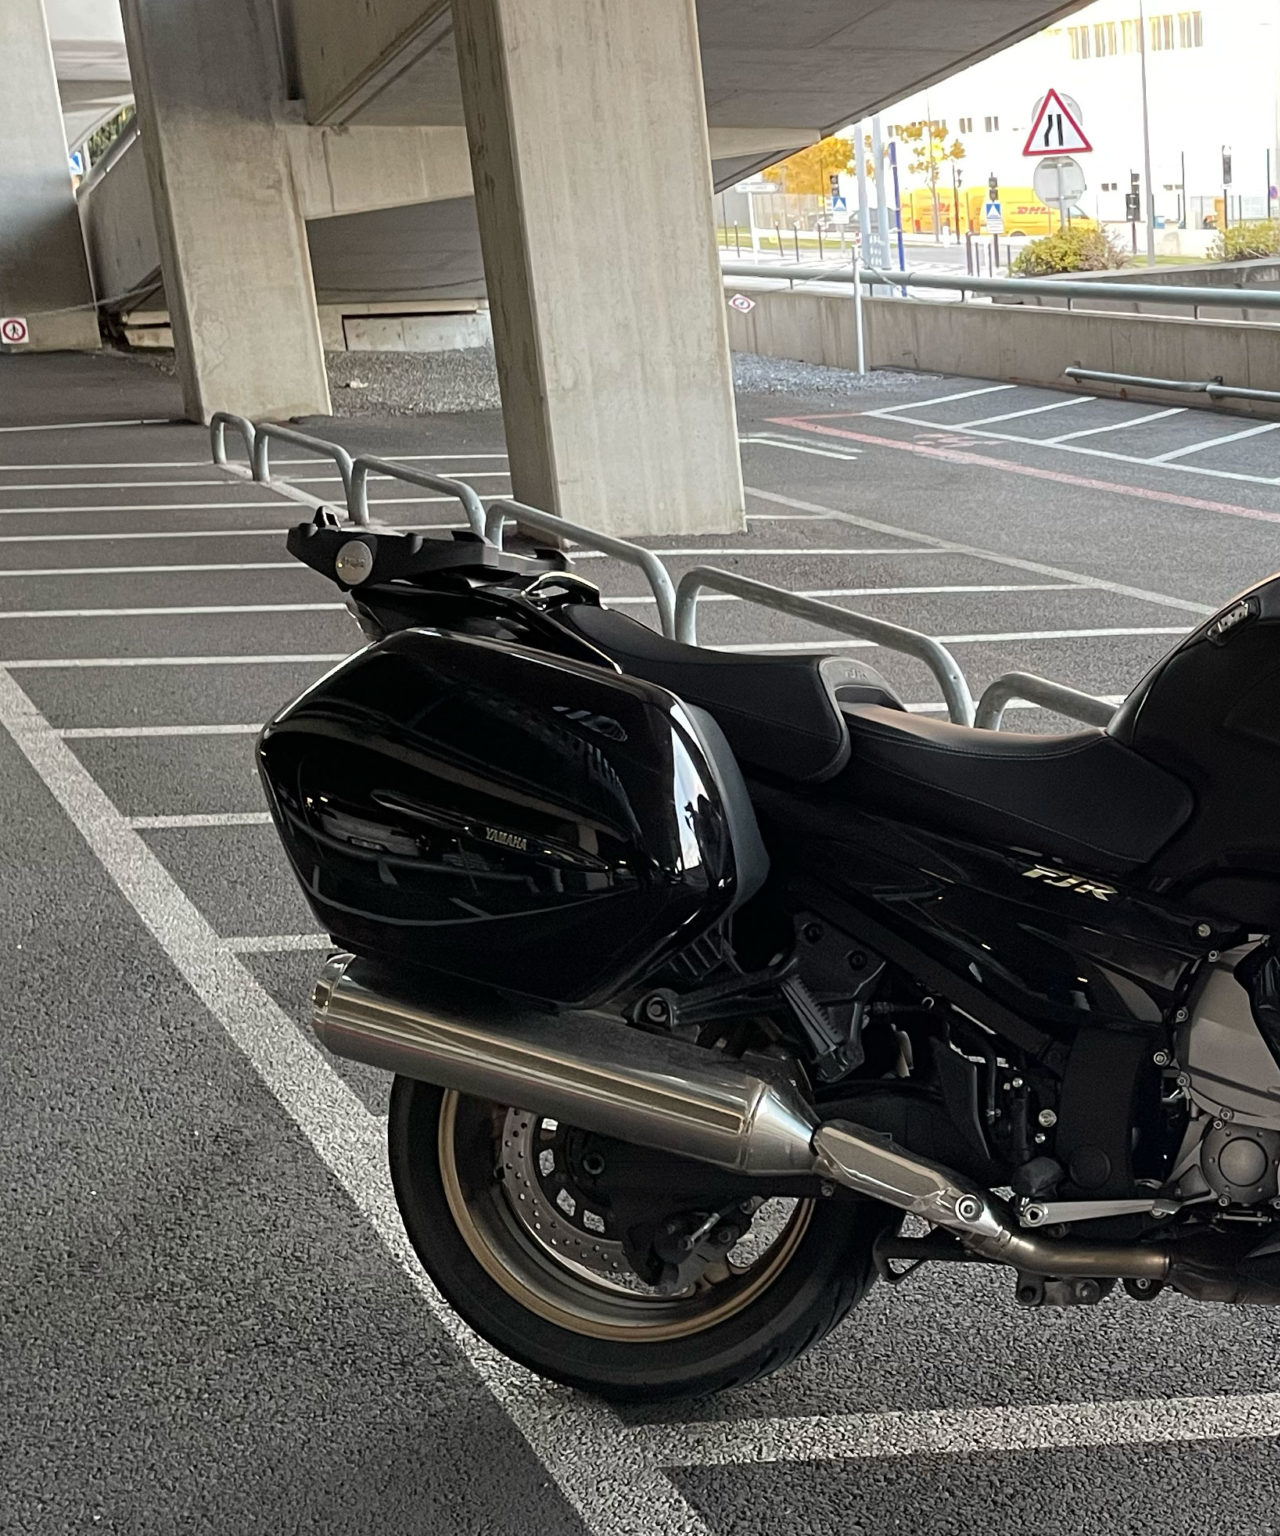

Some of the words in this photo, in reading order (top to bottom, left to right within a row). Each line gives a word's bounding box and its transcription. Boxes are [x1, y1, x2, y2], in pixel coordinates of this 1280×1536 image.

[1016, 206, 1050, 215] DHL
[486, 827, 527, 851] YAMAHA
[1021, 863, 1118, 901] FJR
